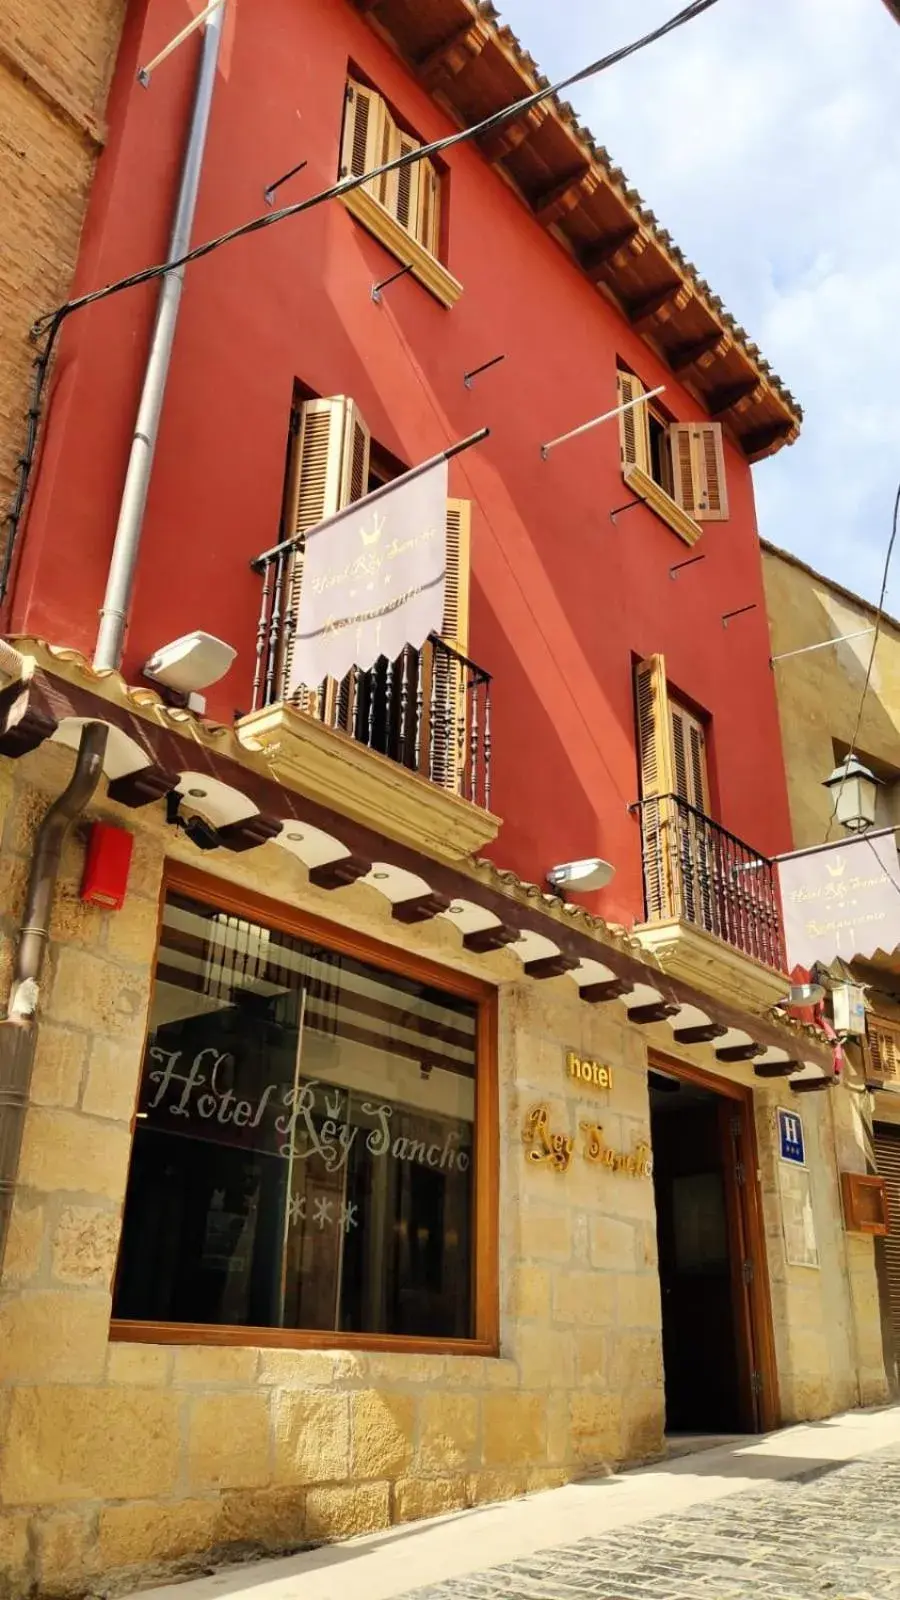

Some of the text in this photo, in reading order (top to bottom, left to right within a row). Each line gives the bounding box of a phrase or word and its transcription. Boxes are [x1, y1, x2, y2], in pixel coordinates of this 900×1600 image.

[566, 1051, 613, 1089] hotel
[148, 1046, 469, 1172] Hotel Rey Sancho
[784, 1115, 798, 1144] H
[522, 1104, 573, 1171] Rey
